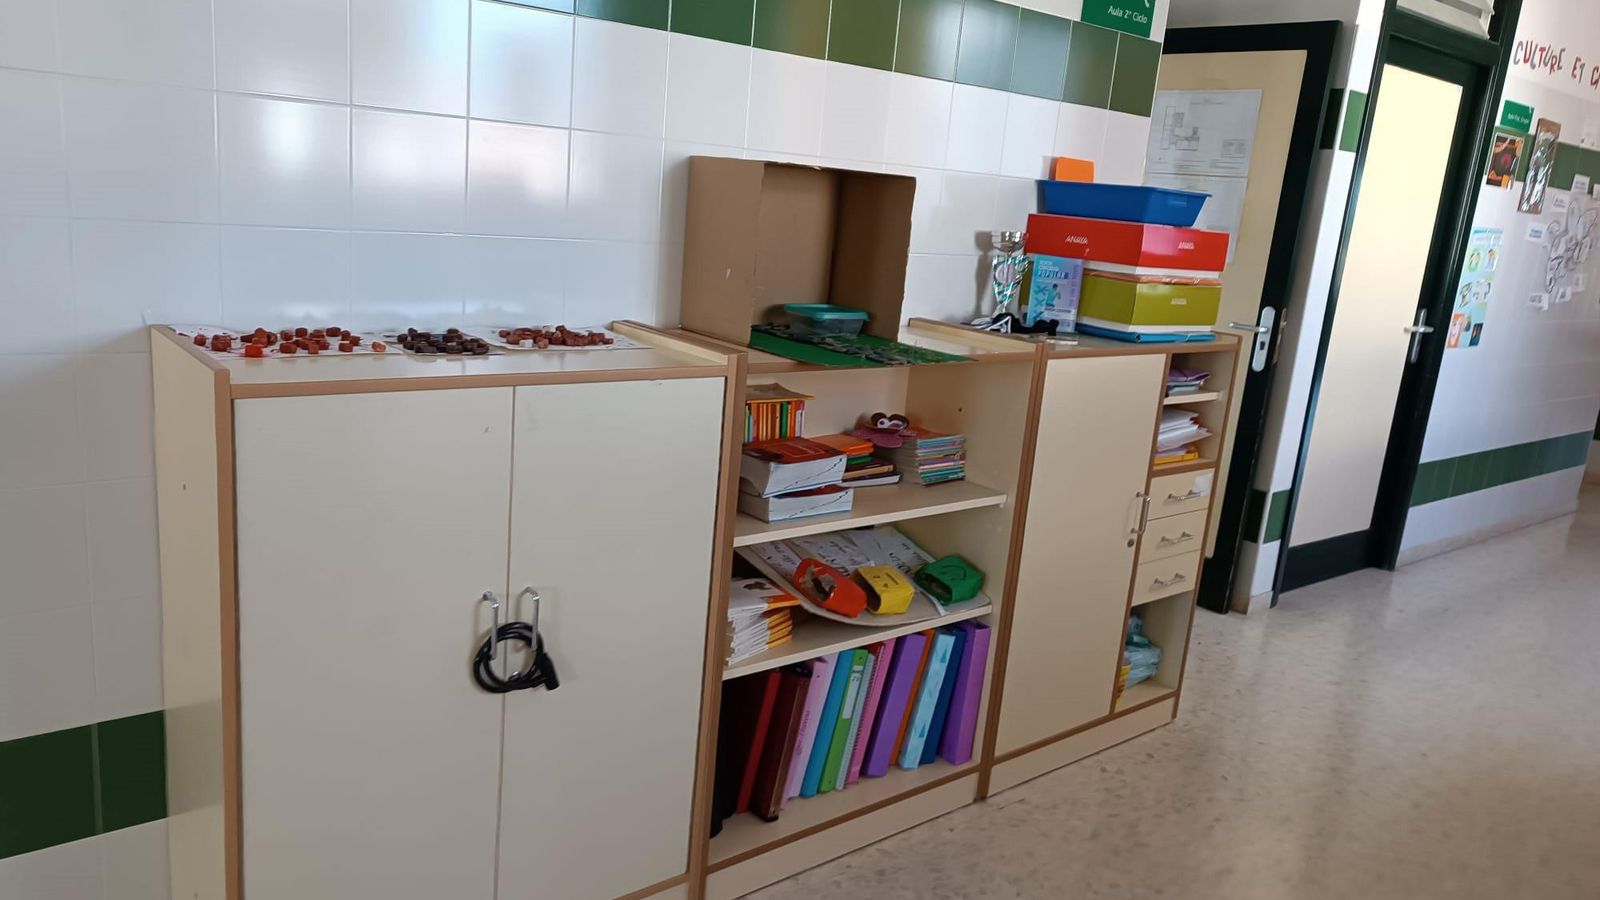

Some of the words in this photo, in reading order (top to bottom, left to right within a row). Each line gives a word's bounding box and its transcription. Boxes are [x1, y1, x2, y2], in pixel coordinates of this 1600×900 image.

[1107, 5, 1123, 16] Aula
[1132, 12, 1148, 23] Ciclo
[1513, 40, 1566, 75] CULTURE
[1571, 56, 1586, 84] ET
